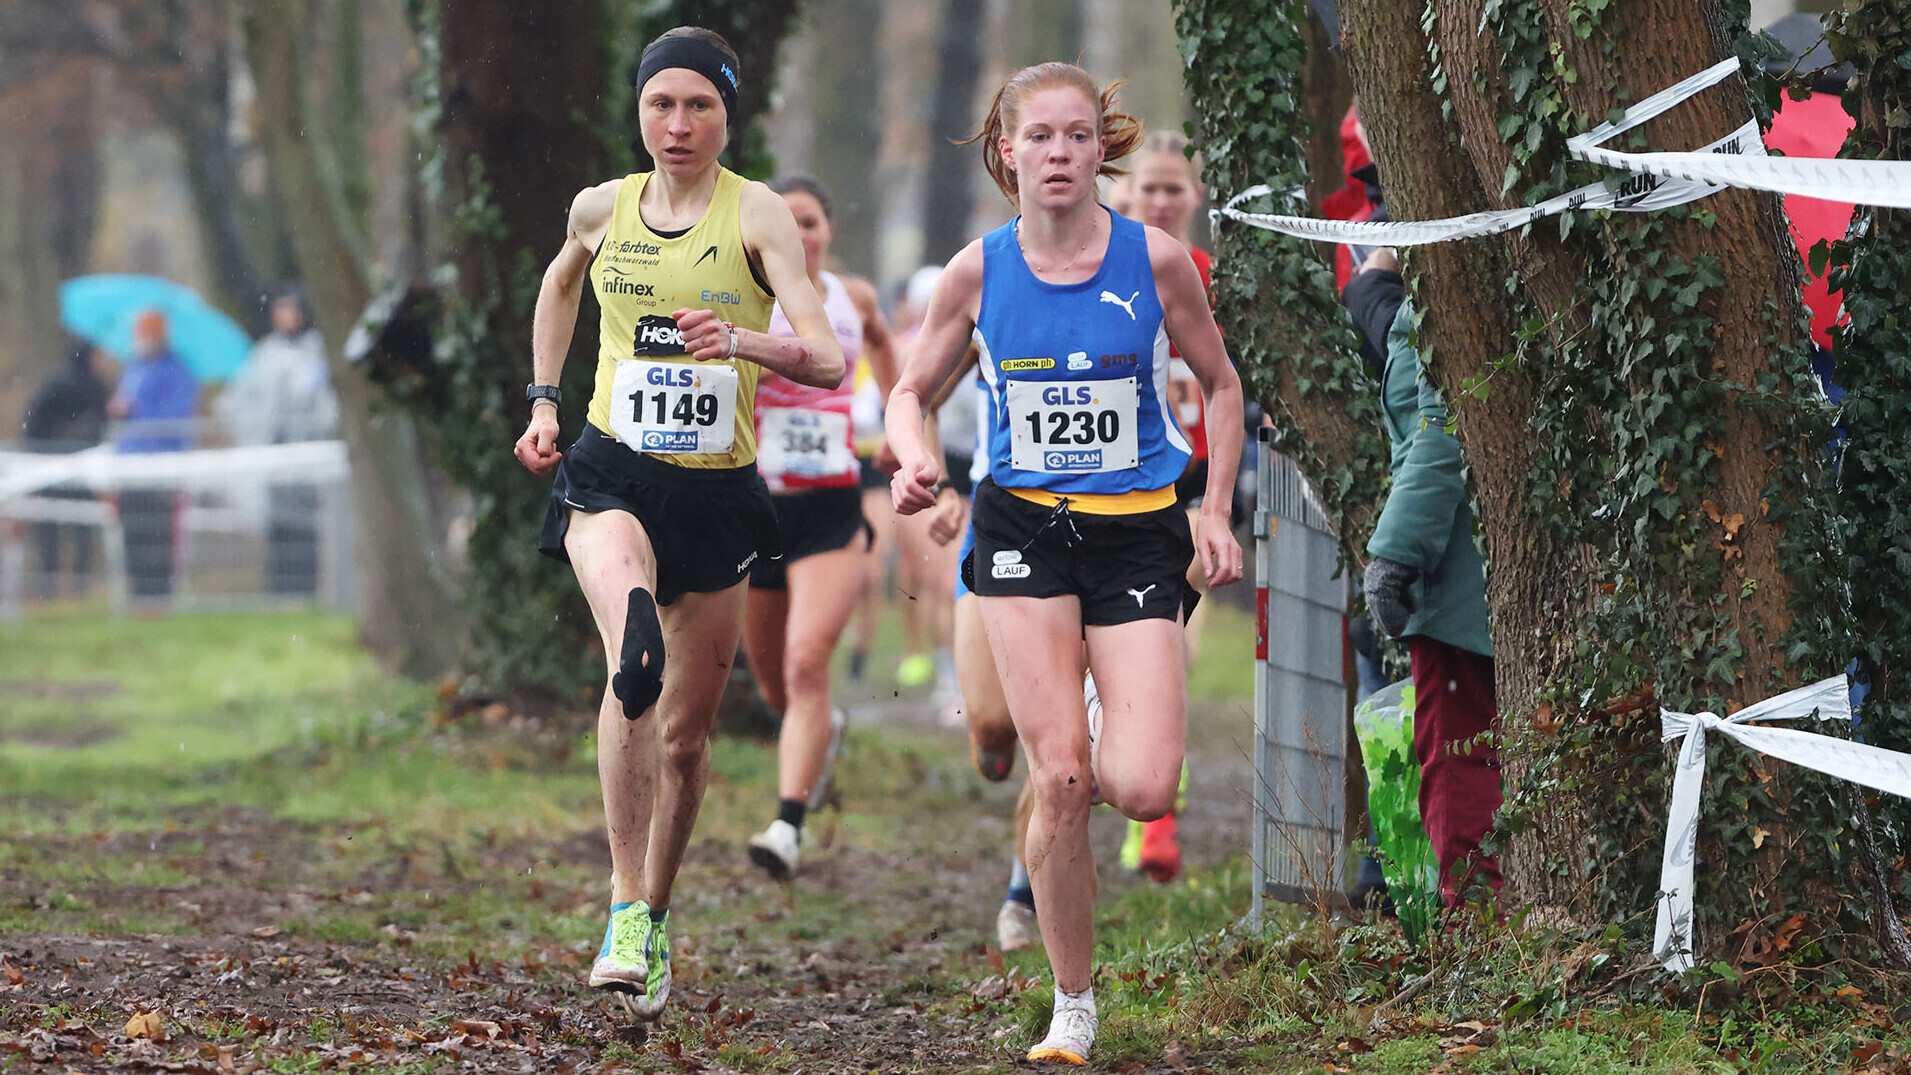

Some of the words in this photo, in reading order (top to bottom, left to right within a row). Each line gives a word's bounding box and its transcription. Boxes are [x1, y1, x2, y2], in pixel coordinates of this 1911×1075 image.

[1619, 173, 1656, 198] RUN
[602, 276, 655, 297] infinex
[636, 298, 657, 308] Group
[701, 289, 741, 306] EnBW
[640, 325, 686, 346] HOK
[1013, 360, 1039, 369] HORN
[628, 389, 719, 427] 1149
[1025, 409, 1120, 445] 1230
[665, 434, 697, 445] PLAN
[782, 429, 828, 456] 384
[1067, 453, 1101, 464] PLAN
[737, 550, 758, 574] HOKA
[997, 566, 1026, 575] LAUF
